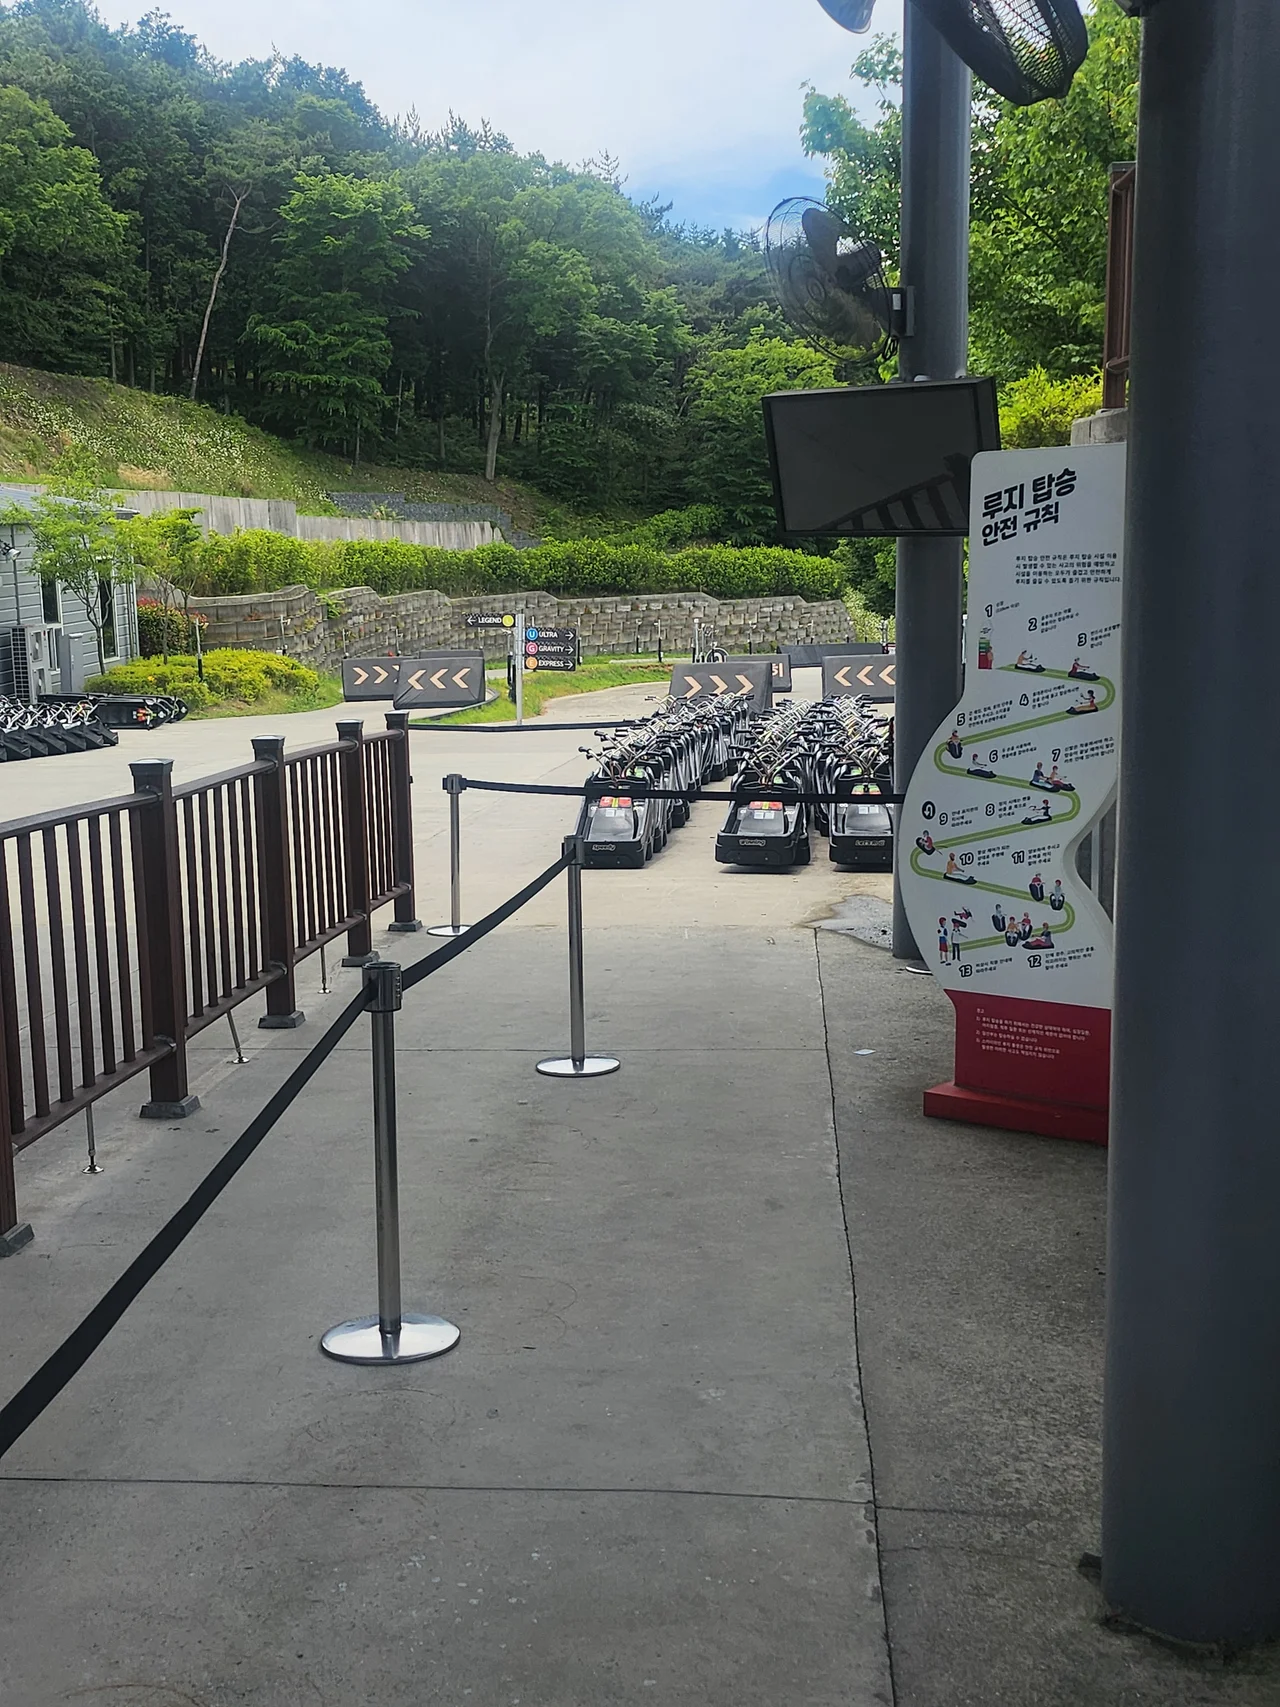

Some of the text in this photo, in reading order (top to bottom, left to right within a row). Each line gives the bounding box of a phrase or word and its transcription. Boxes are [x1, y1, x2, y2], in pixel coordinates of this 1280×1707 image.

[983, 468, 1076, 519] 루지 탑승
[982, 502, 1059, 546] 안전 규칙
[985, 604, 993, 617] 1
[1028, 618, 1037, 631] 2
[1077, 633, 1087, 646] 3
[1020, 694, 1028, 706] 4
[957, 713, 965, 726] 5
[989, 749, 998, 762] 6
[1052, 749, 1060, 762] 7
[986, 803, 994, 816] 8
[939, 813, 948, 825] 9
[960, 852, 974, 866] 10
[1011, 851, 1024, 864] 11
[1028, 955, 1041, 968] 12
[959, 964, 972, 977] 13
